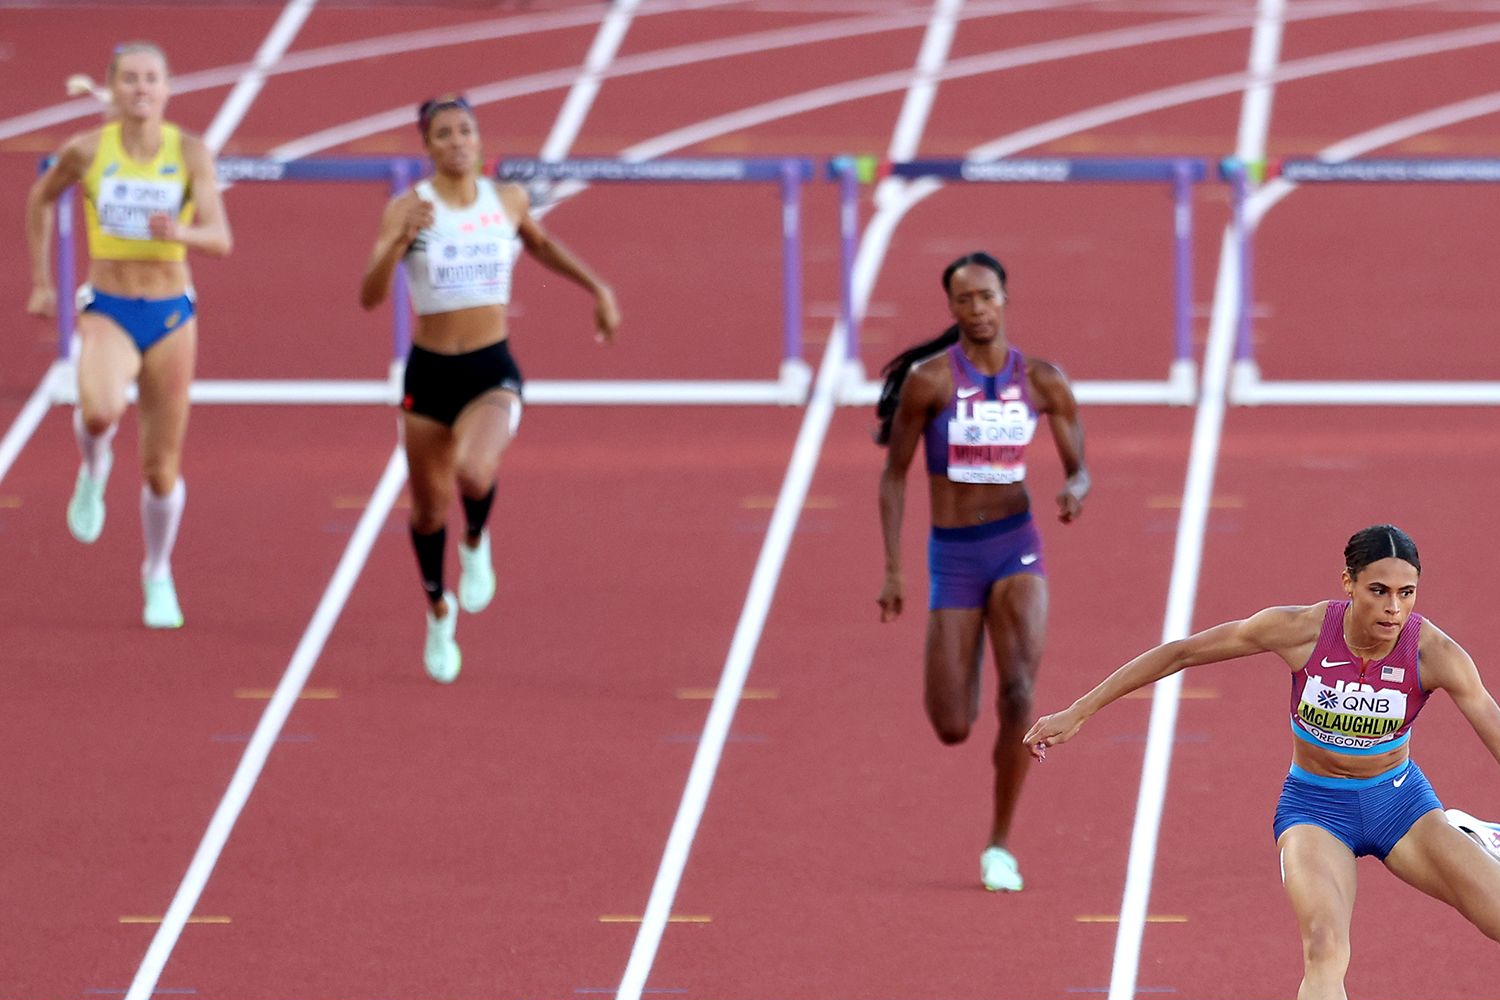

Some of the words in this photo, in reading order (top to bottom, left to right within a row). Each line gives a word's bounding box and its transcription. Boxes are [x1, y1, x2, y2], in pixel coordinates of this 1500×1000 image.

[986, 426, 1024, 441] QNB
[1342, 696, 1390, 713] QNB
[1302, 704, 1399, 736] McLAUGHLIN
